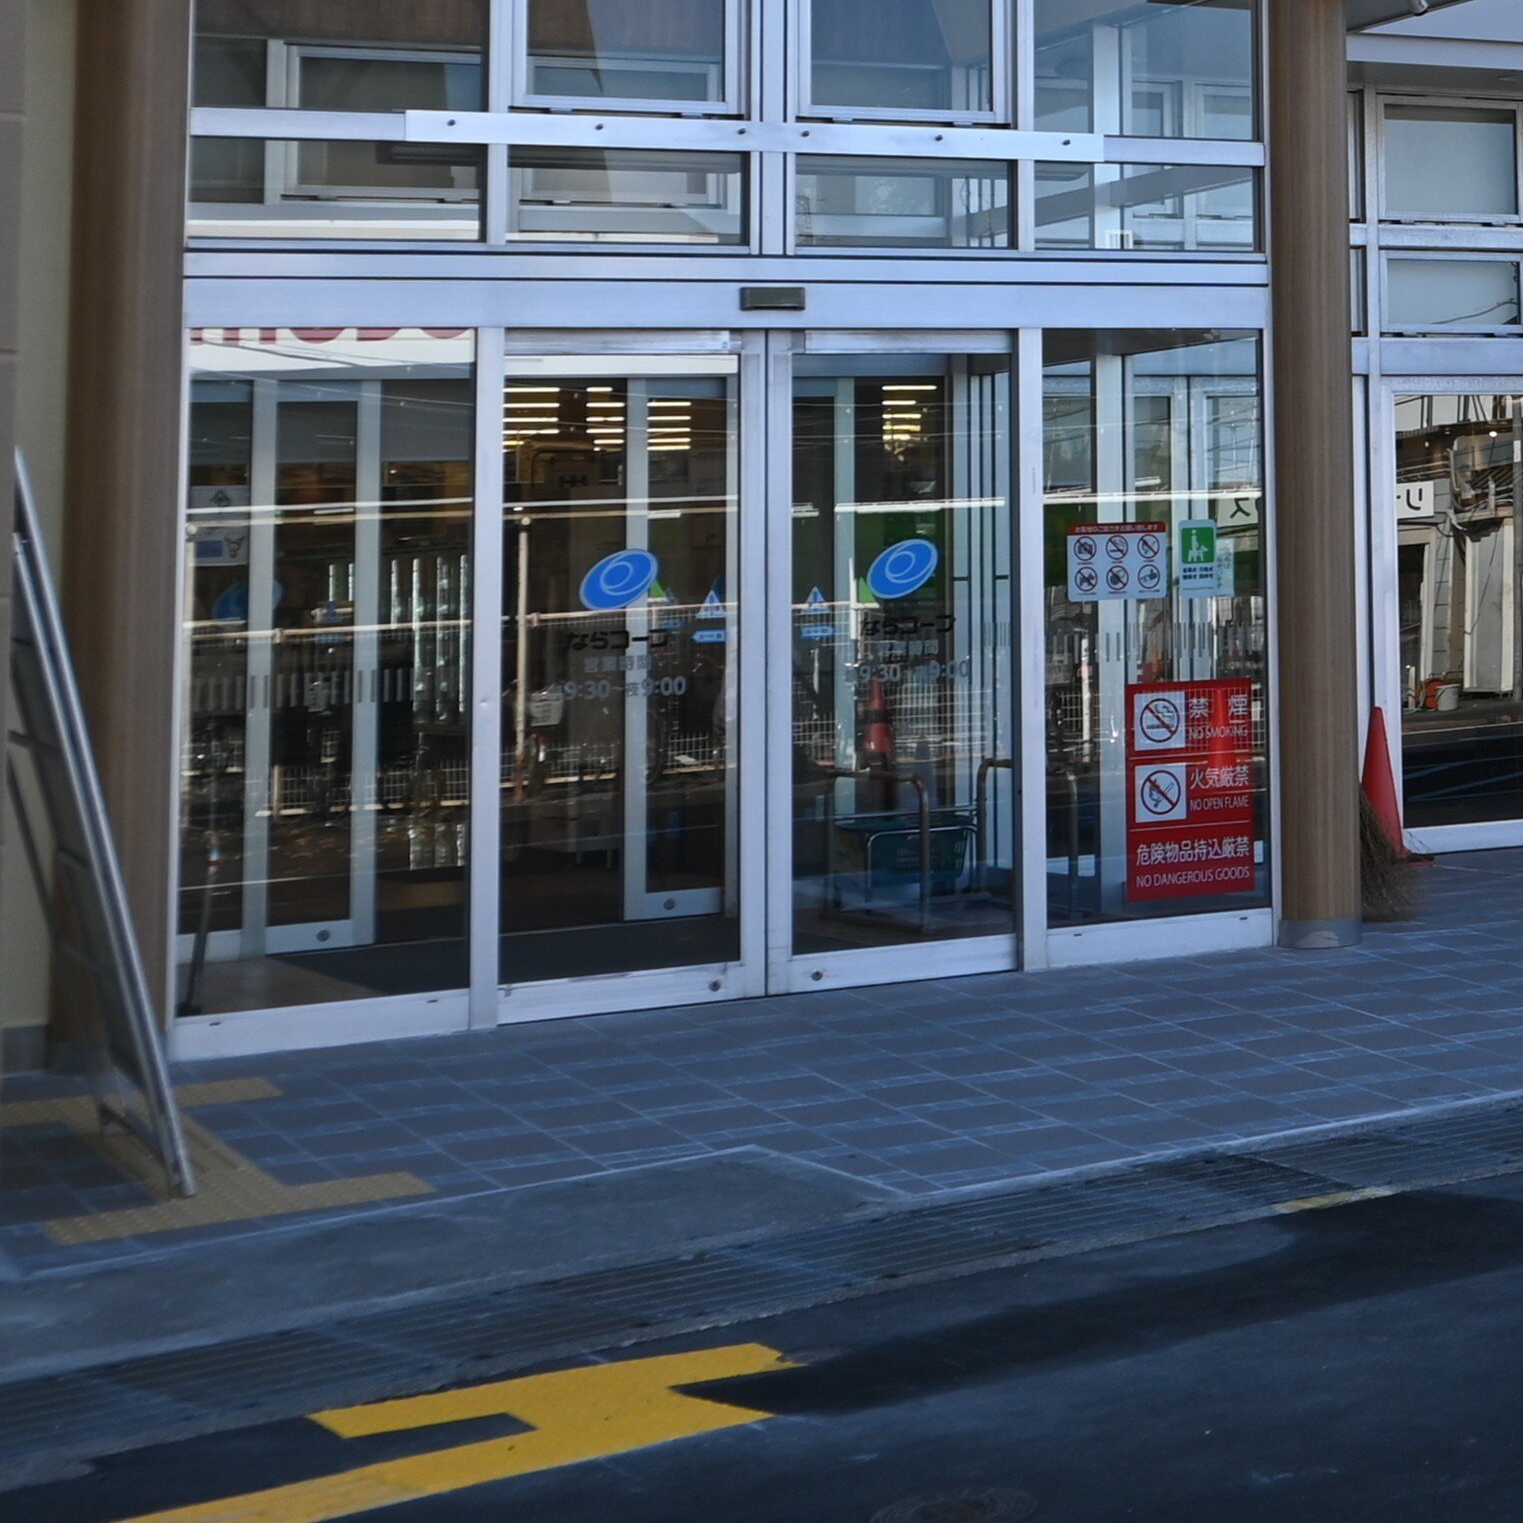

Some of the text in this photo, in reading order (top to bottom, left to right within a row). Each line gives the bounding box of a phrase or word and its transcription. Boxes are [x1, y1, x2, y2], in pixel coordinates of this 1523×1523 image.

[1189, 725, 1248, 739] NO SMOKING
[1190, 766, 1249, 790] 火気厳禁
[1190, 795, 1249, 811] NO OPEN FLAME
[1136, 836, 1250, 866] 危険物品持込厳禁
[1136, 866, 1250, 888] NO DANGEROUS GOODS
